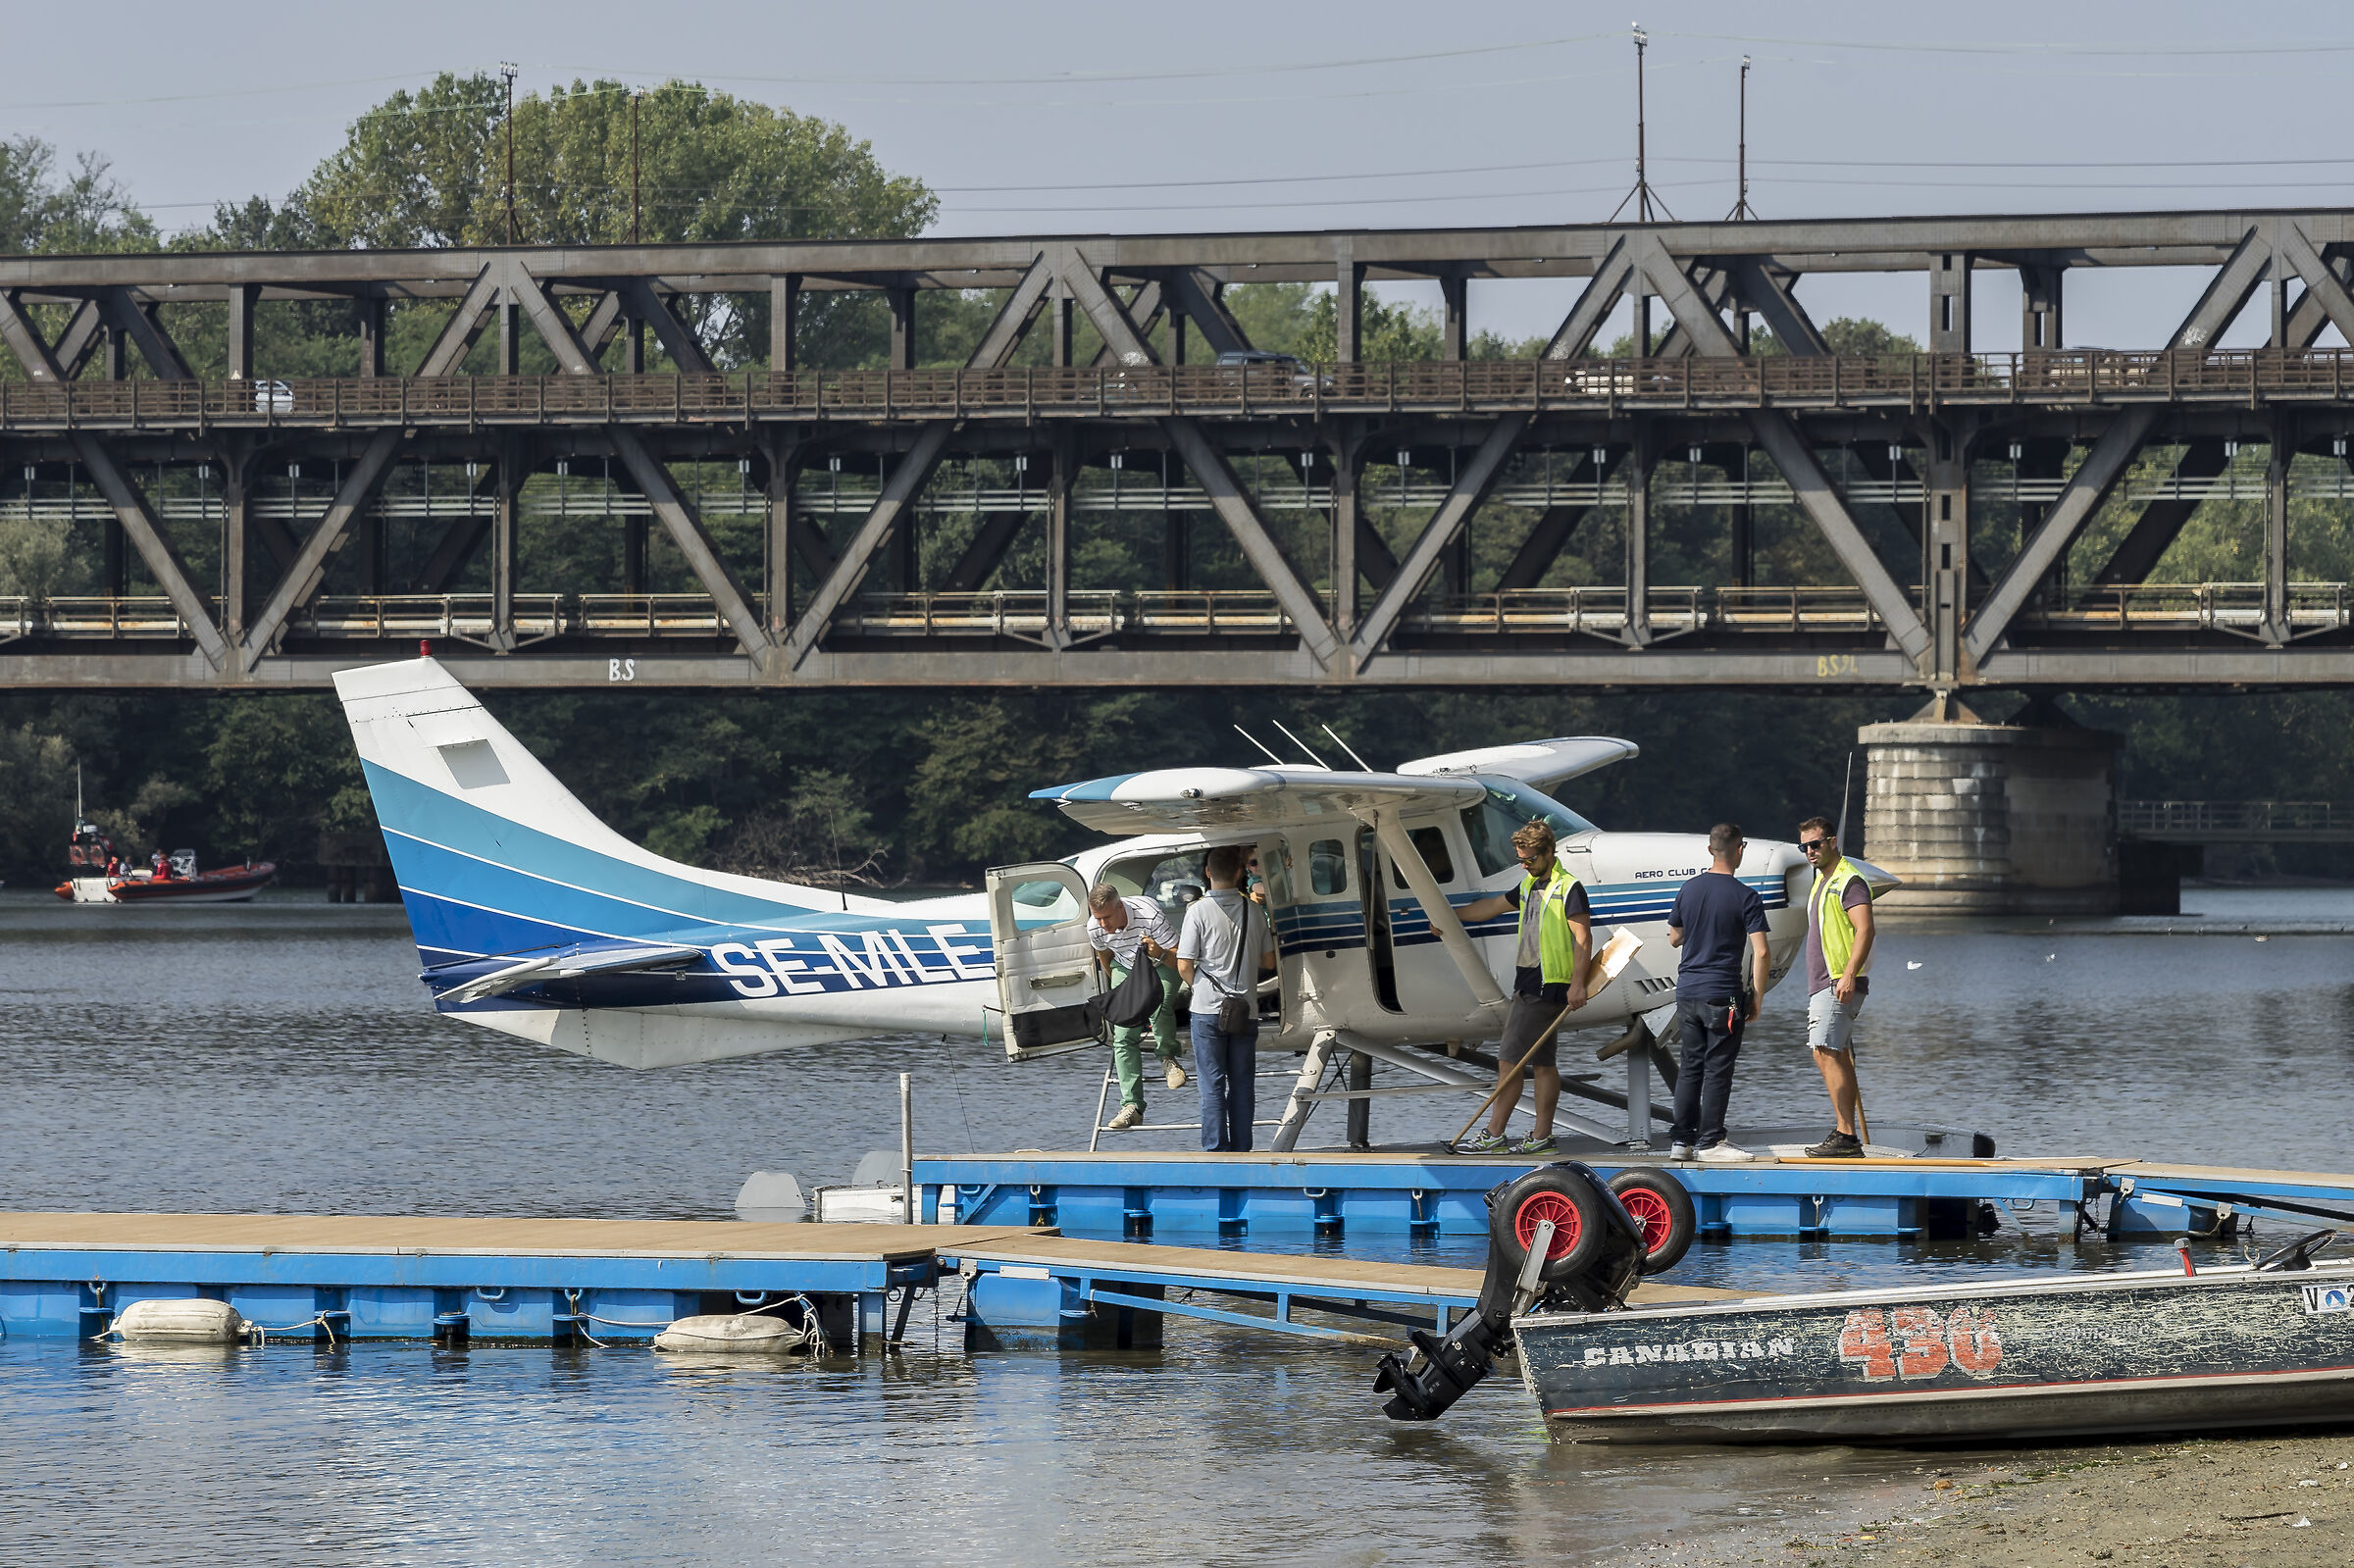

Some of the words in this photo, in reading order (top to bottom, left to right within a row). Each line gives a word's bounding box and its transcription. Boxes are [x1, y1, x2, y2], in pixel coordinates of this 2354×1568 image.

[1634, 870, 1663, 880] AERO
[1667, 868, 1696, 877] CLUB
[709, 923, 997, 998] SE-MLE
[1583, 1338, 1795, 1366] CANADIAN
